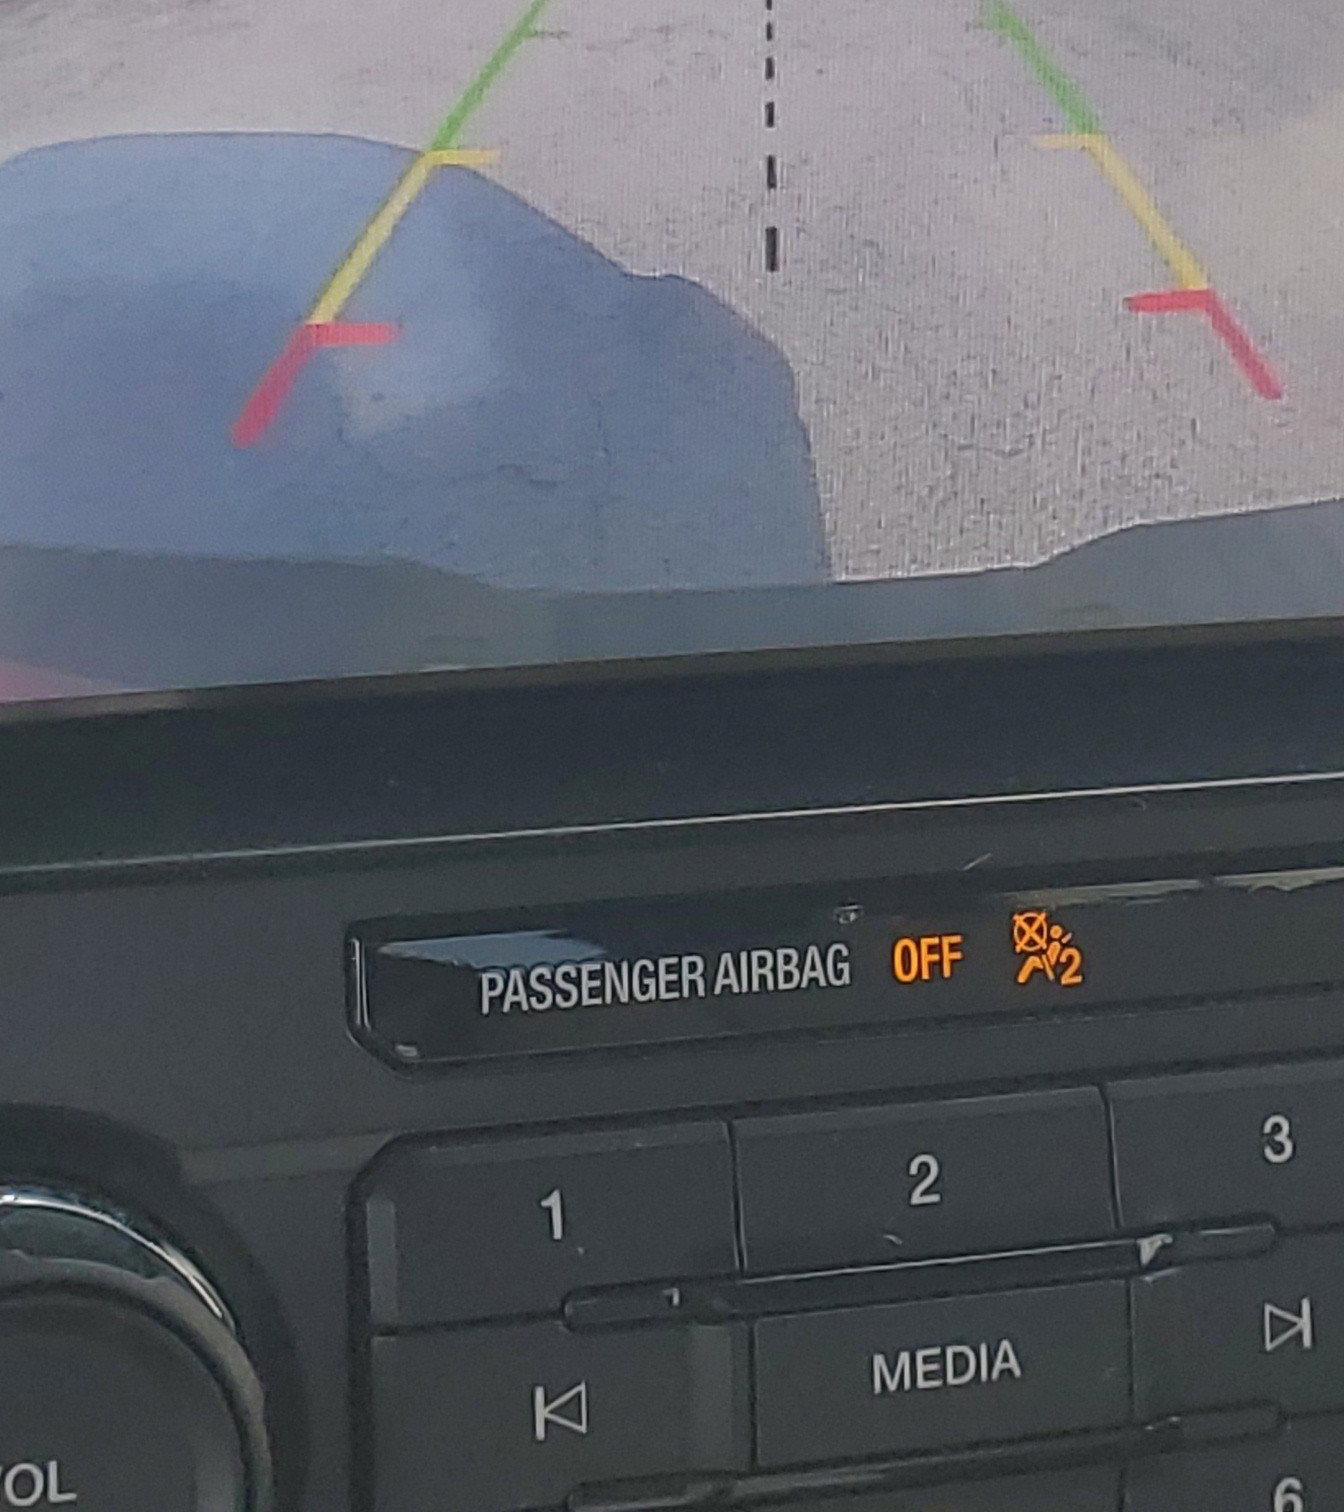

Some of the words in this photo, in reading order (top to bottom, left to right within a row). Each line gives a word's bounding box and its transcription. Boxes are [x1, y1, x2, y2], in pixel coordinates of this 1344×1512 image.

[479, 956, 706, 1015] PASSENGER
[712, 941, 852, 996] AIRBAG
[892, 934, 963, 984] OFF
[1261, 1115, 1295, 1164] 3
[907, 1155, 941, 1207] 2
[540, 1189, 565, 1241] 1
[870, 1340, 1022, 1394] MEDIA
